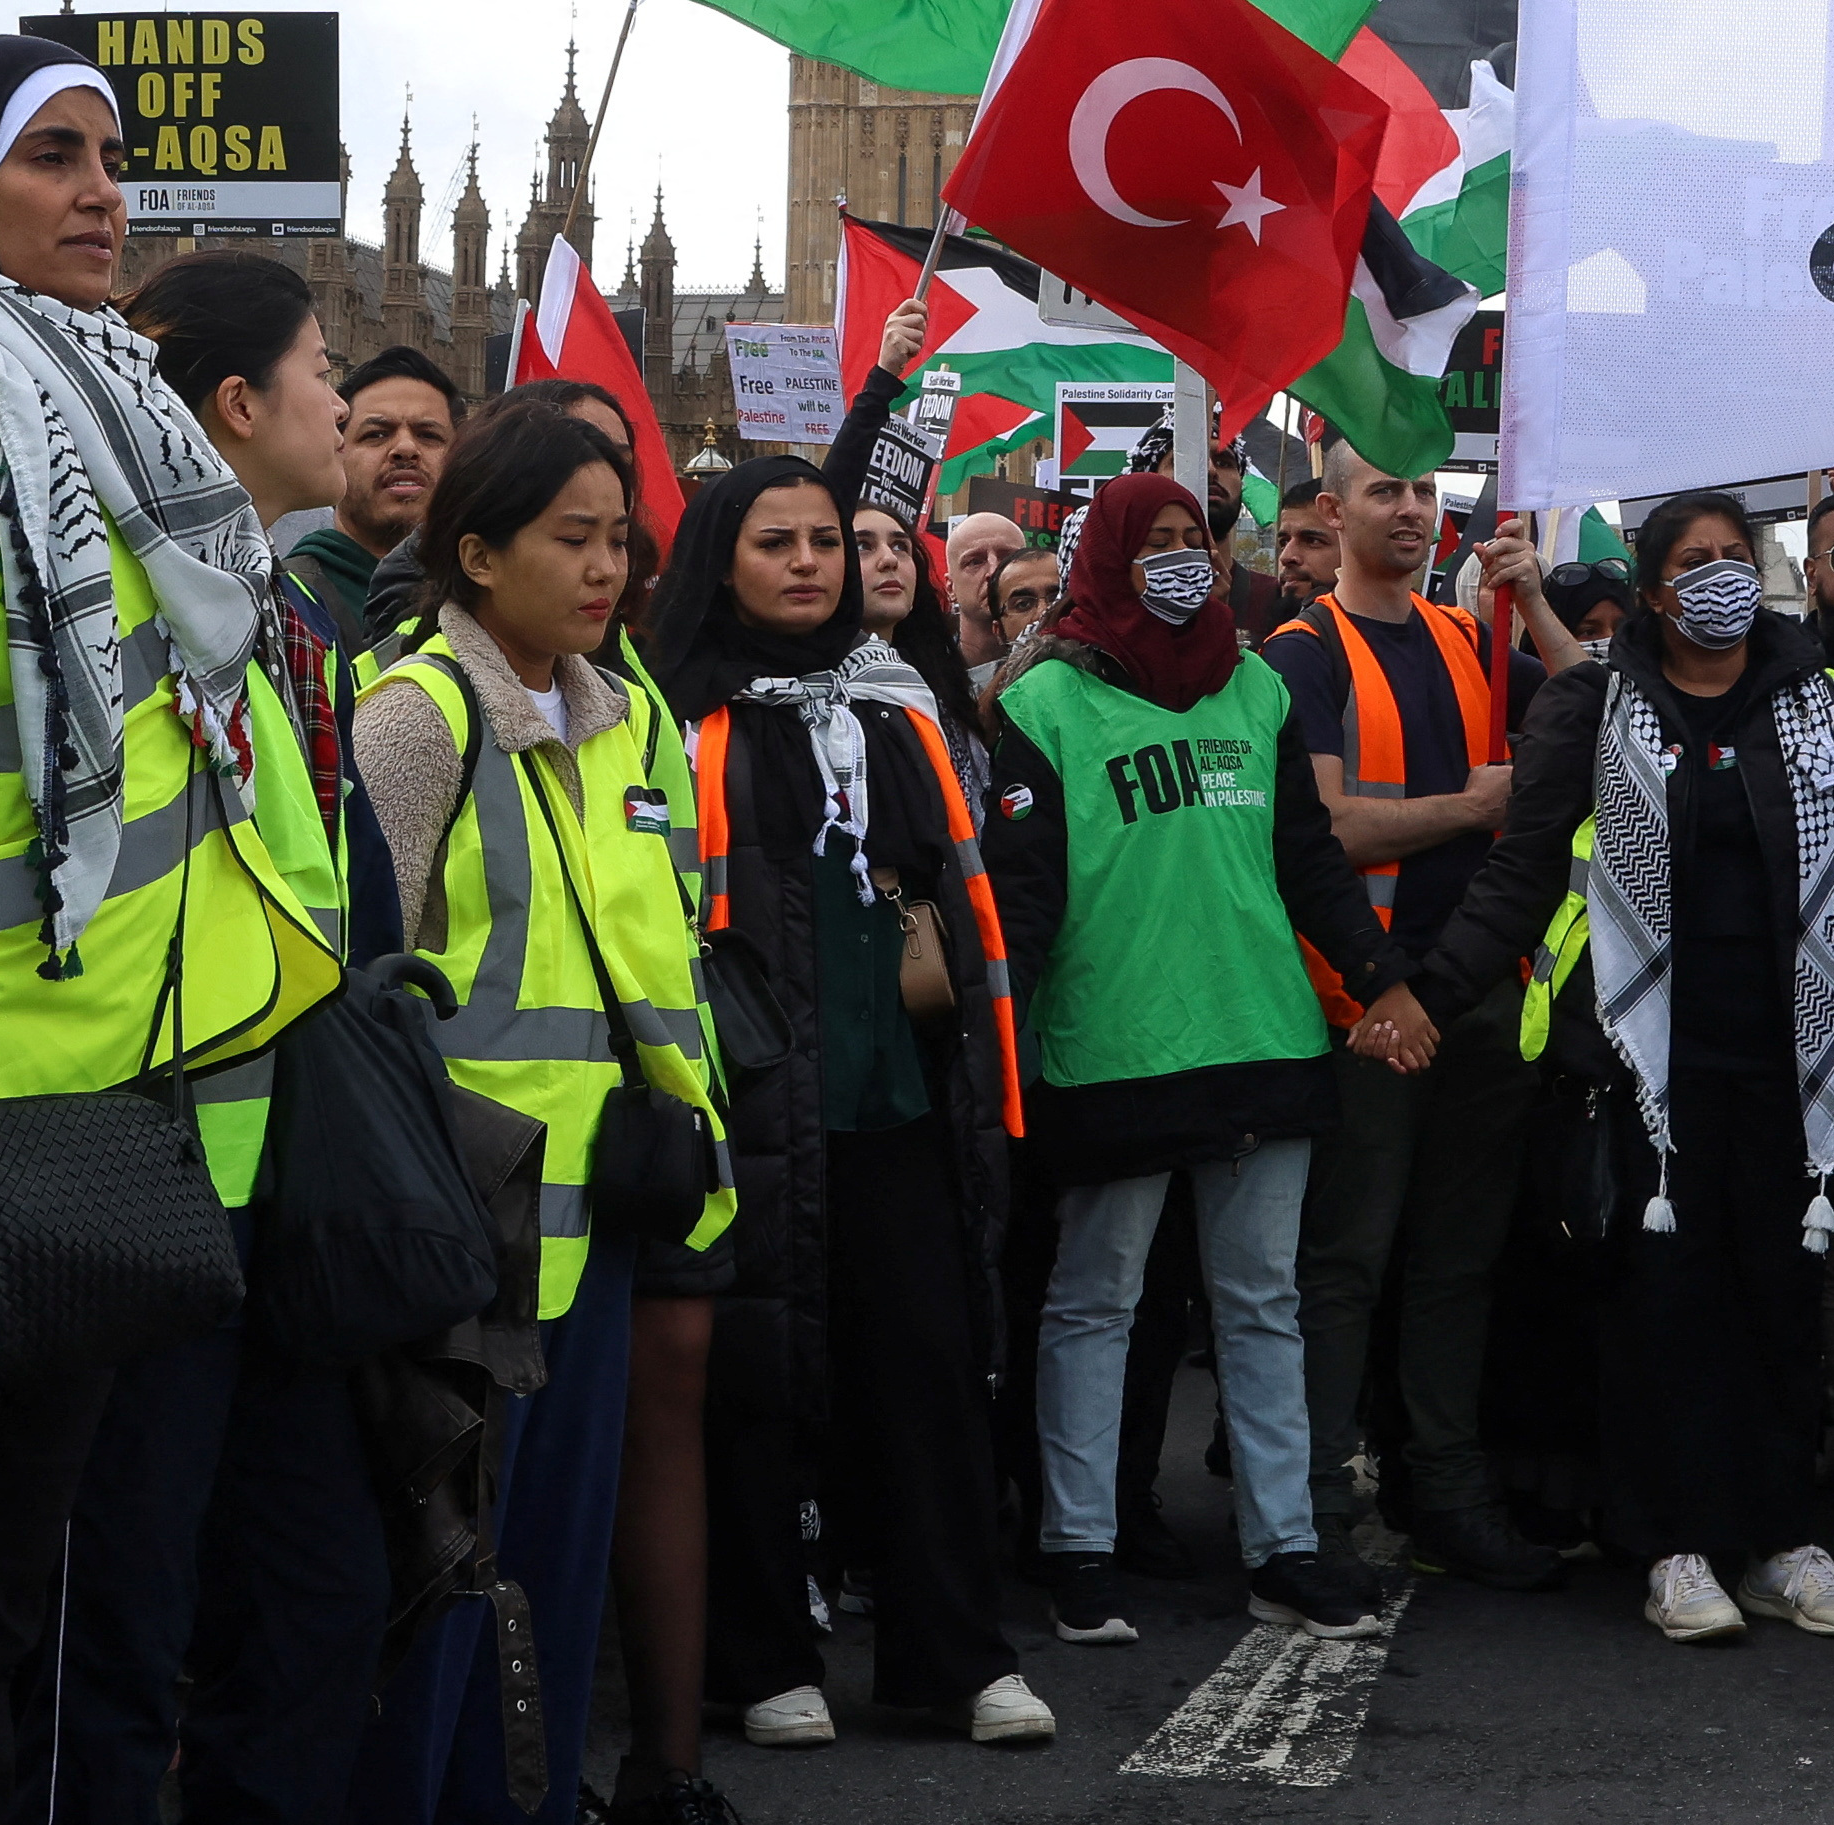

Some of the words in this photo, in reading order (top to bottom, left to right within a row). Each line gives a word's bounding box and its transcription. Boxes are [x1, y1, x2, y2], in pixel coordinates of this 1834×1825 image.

[98, 19, 265, 66] HANDS
[137, 72, 221, 118] OFF
[139, 189, 170, 211] FOA
[177, 189, 215, 201] FRIENDS
[177, 202, 185, 211] OF
[187, 202, 215, 211] AL-AQSA
[781, 334, 797, 343] From
[798, 335, 810, 343] The
[734, 338, 769, 358] Free
[789, 348, 797, 356] To
[799, 348, 811, 357] The
[812, 349, 825, 359] SEA
[739, 375, 774, 394] Free
[785, 377, 838, 391] PALESTINE
[1062, 388, 1105, 399] Palestine
[1107, 388, 1152, 400] Solidarity
[798, 400, 815, 412] will
[818, 402, 831, 413] be
[737, 409, 786, 424] Palestine
[804, 423, 830, 435] FREE
[881, 472, 894, 490] for
[1196, 739, 1238, 755] FRIENDS
[1240, 740, 1252, 755] OF
[1200, 755, 1244, 771] AL-AQSA
[1105, 739, 1206, 826] FOA
[1201, 772, 1237, 789] PEACE
[1204, 791, 1217, 808] IN
[1218, 789, 1266, 808] PALESTINE
